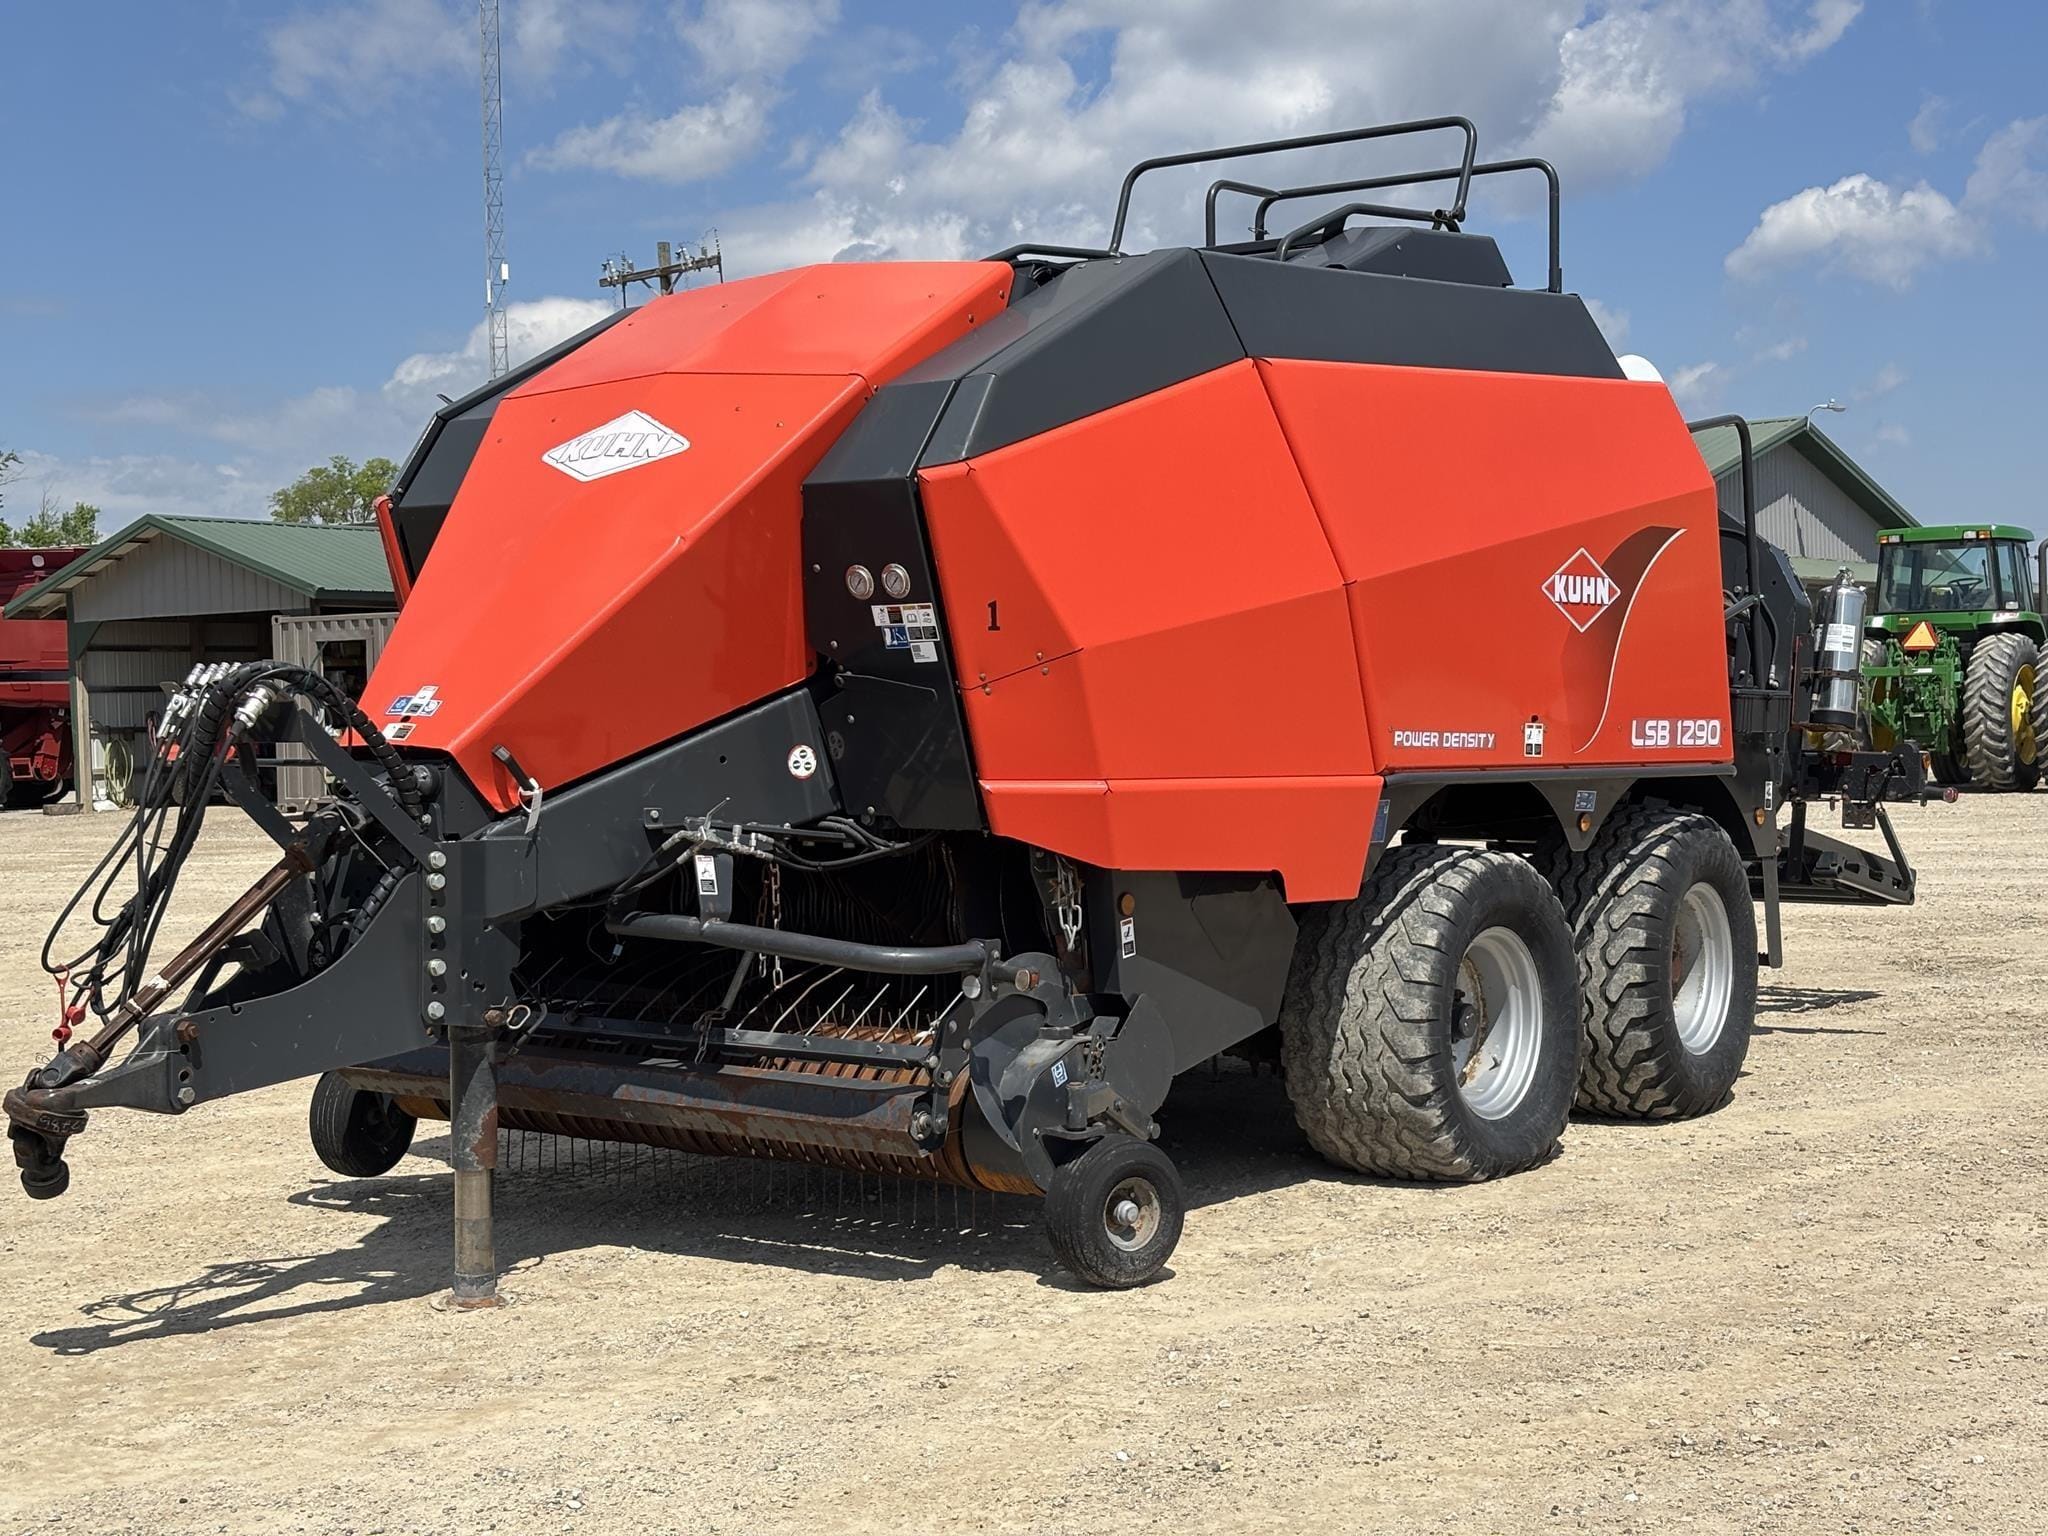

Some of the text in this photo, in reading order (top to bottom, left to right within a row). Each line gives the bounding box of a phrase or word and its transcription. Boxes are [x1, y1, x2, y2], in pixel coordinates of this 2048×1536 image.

[557, 432, 673, 463] KUHN
[1554, 574, 1609, 605] KUHN
[987, 599, 1001, 631] 1
[1393, 730, 1495, 748] POWER DENSITY
[1631, 719, 1720, 746] LSB 1290
